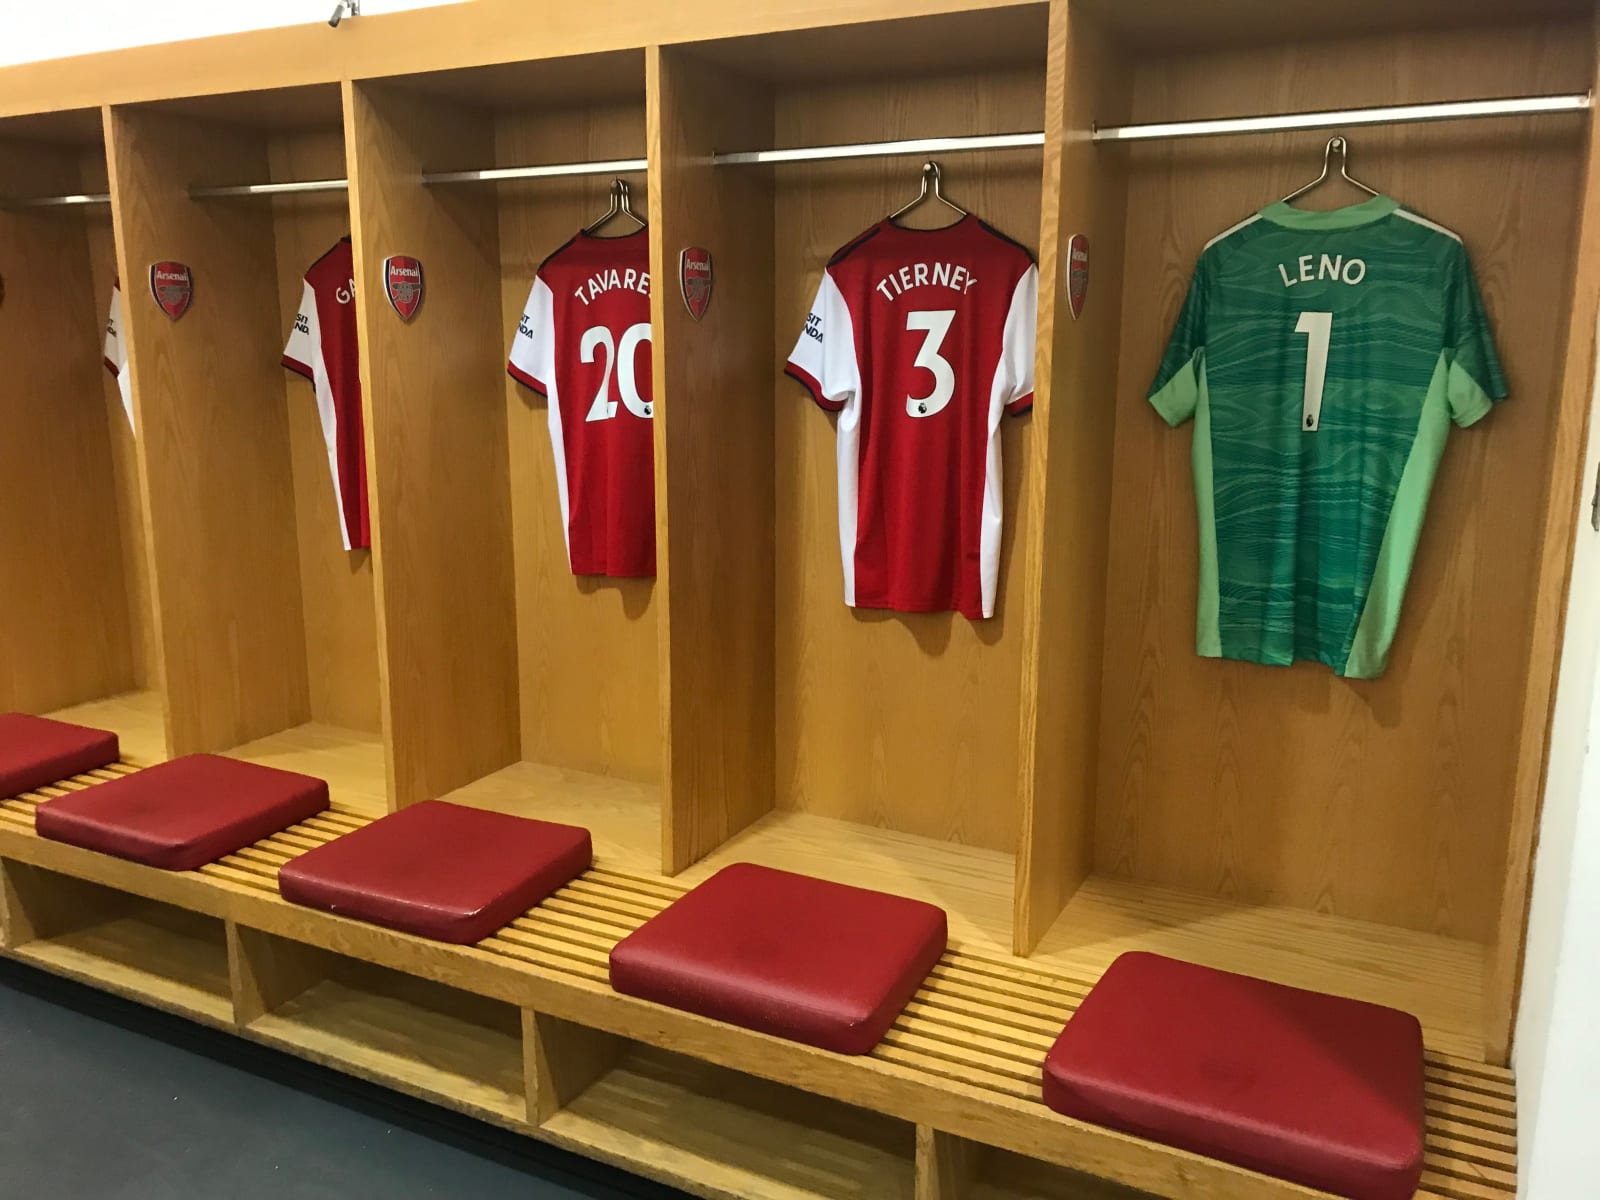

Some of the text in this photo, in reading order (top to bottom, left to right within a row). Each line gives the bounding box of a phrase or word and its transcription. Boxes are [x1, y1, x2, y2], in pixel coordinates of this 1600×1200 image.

[156, 270, 188, 281] Arsenal
[390, 265, 419, 277] Arsenal
[574, 268, 652, 306] TAVARE
[876, 262, 977, 301] TIERNEY
[1278, 253, 1366, 288] LENO
[580, 322, 653, 422] 20
[906, 310, 956, 418] 3
[1295, 311, 1333, 431] 1
